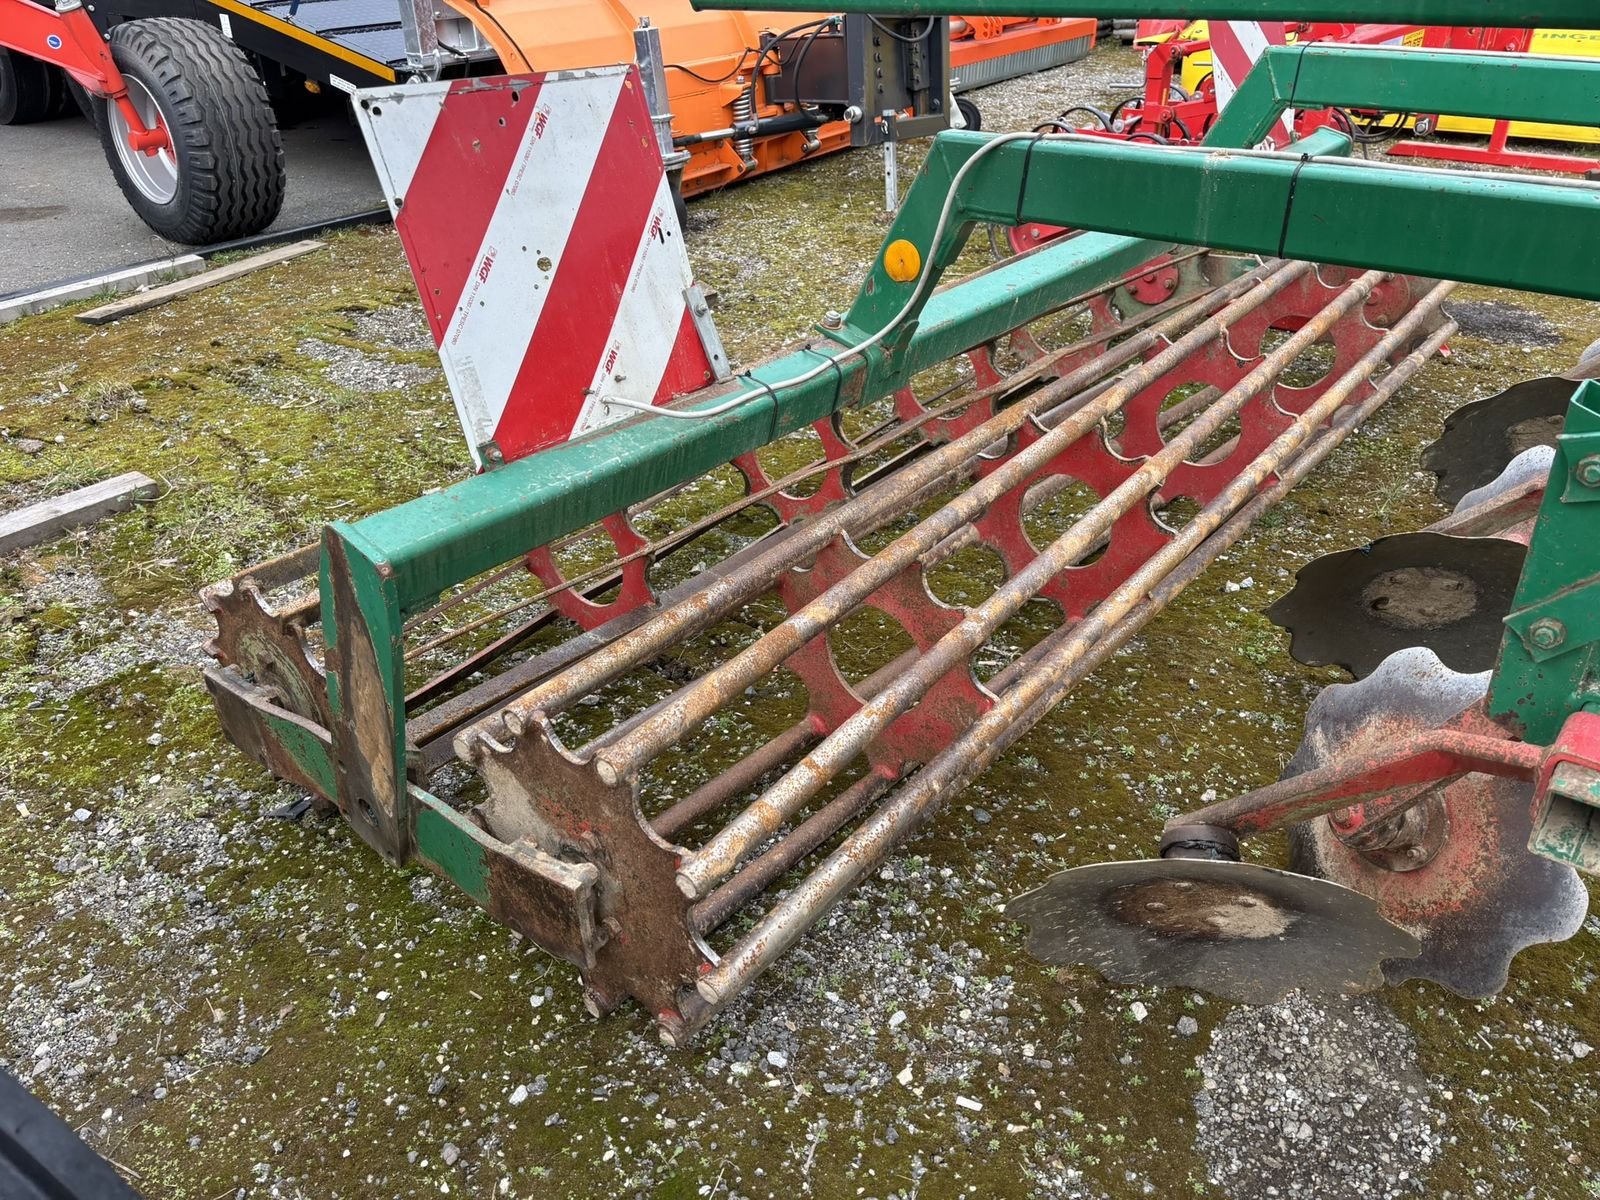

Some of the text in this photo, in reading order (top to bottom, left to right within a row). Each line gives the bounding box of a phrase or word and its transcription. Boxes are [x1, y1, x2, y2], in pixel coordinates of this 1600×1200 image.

[534, 113, 548, 138] WGF
[650, 216, 661, 239] WGF
[478, 256, 493, 282] WGF
[472, 280, 480, 292] DIN
[604, 350, 617, 374] WGF
